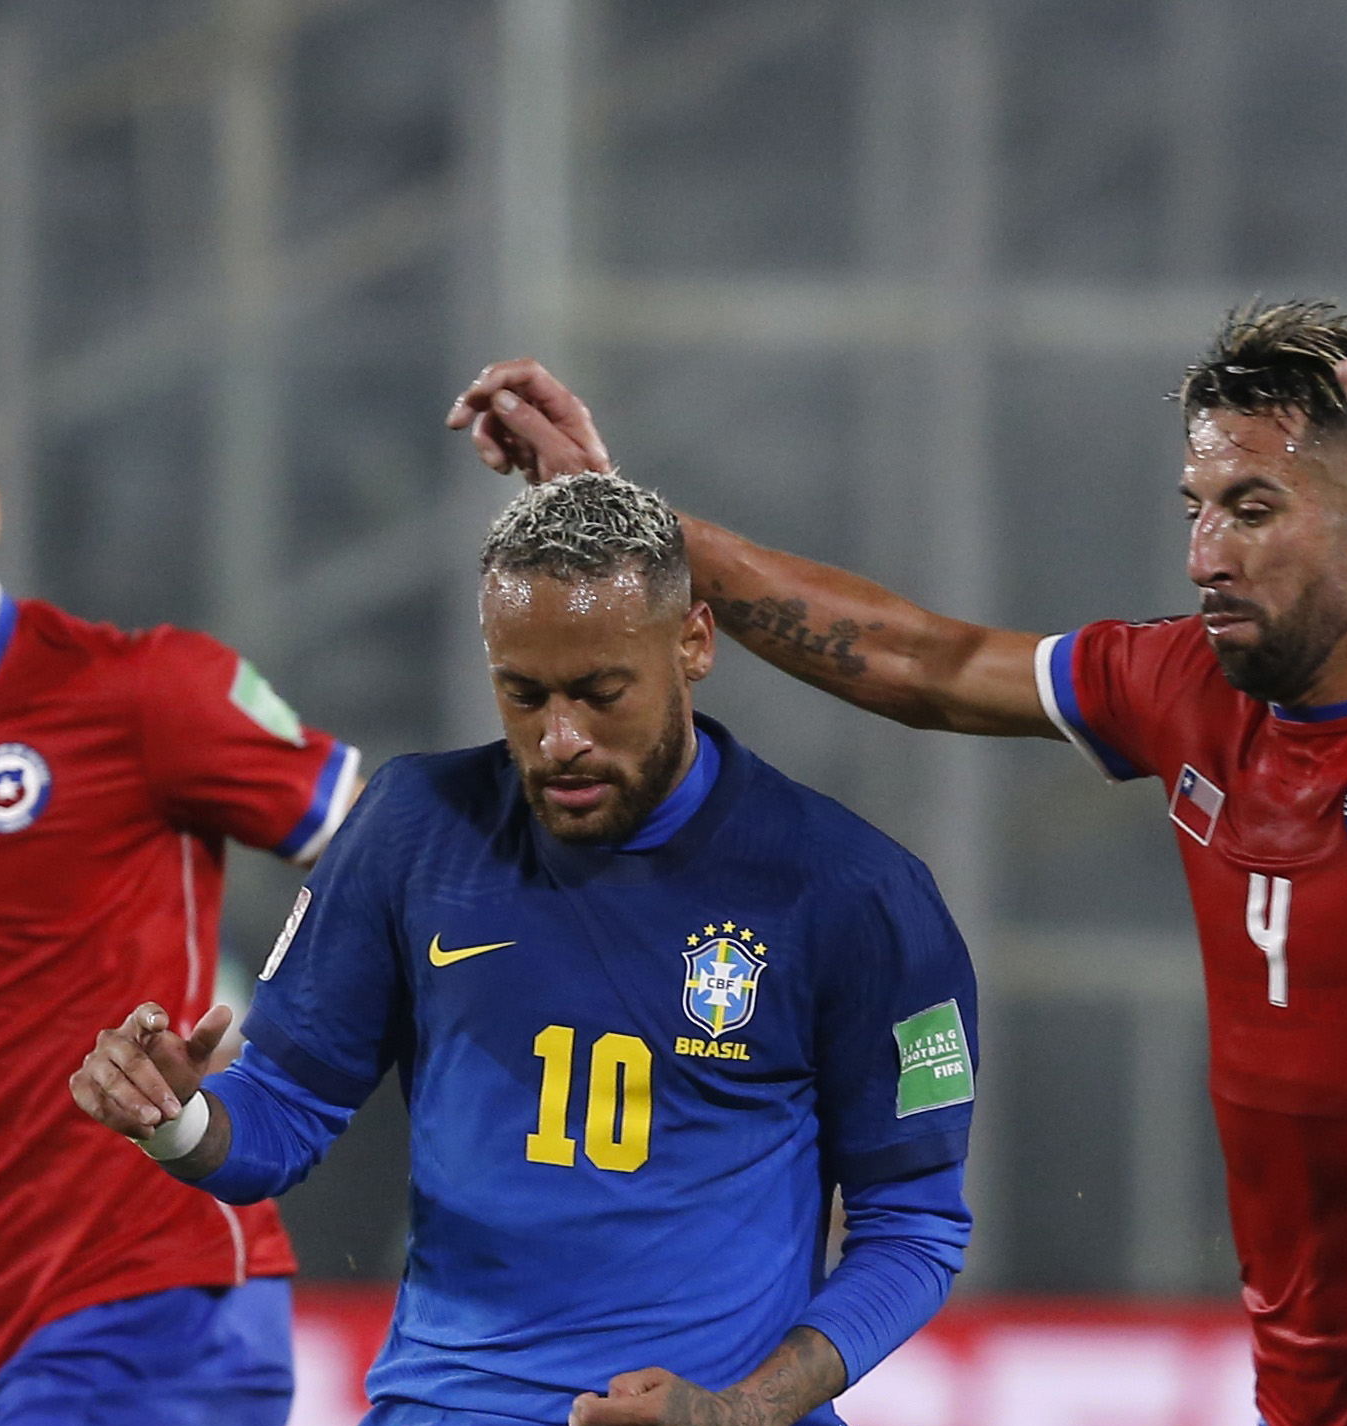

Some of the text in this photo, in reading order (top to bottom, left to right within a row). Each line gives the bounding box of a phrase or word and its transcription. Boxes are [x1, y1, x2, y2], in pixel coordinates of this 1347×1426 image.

[1246, 872, 1293, 1008] 4
[707, 978, 735, 991] CBF
[675, 1037, 751, 1061] BRASIL
[933, 1062, 964, 1079] FIFA
[525, 1025, 652, 1173] 10
